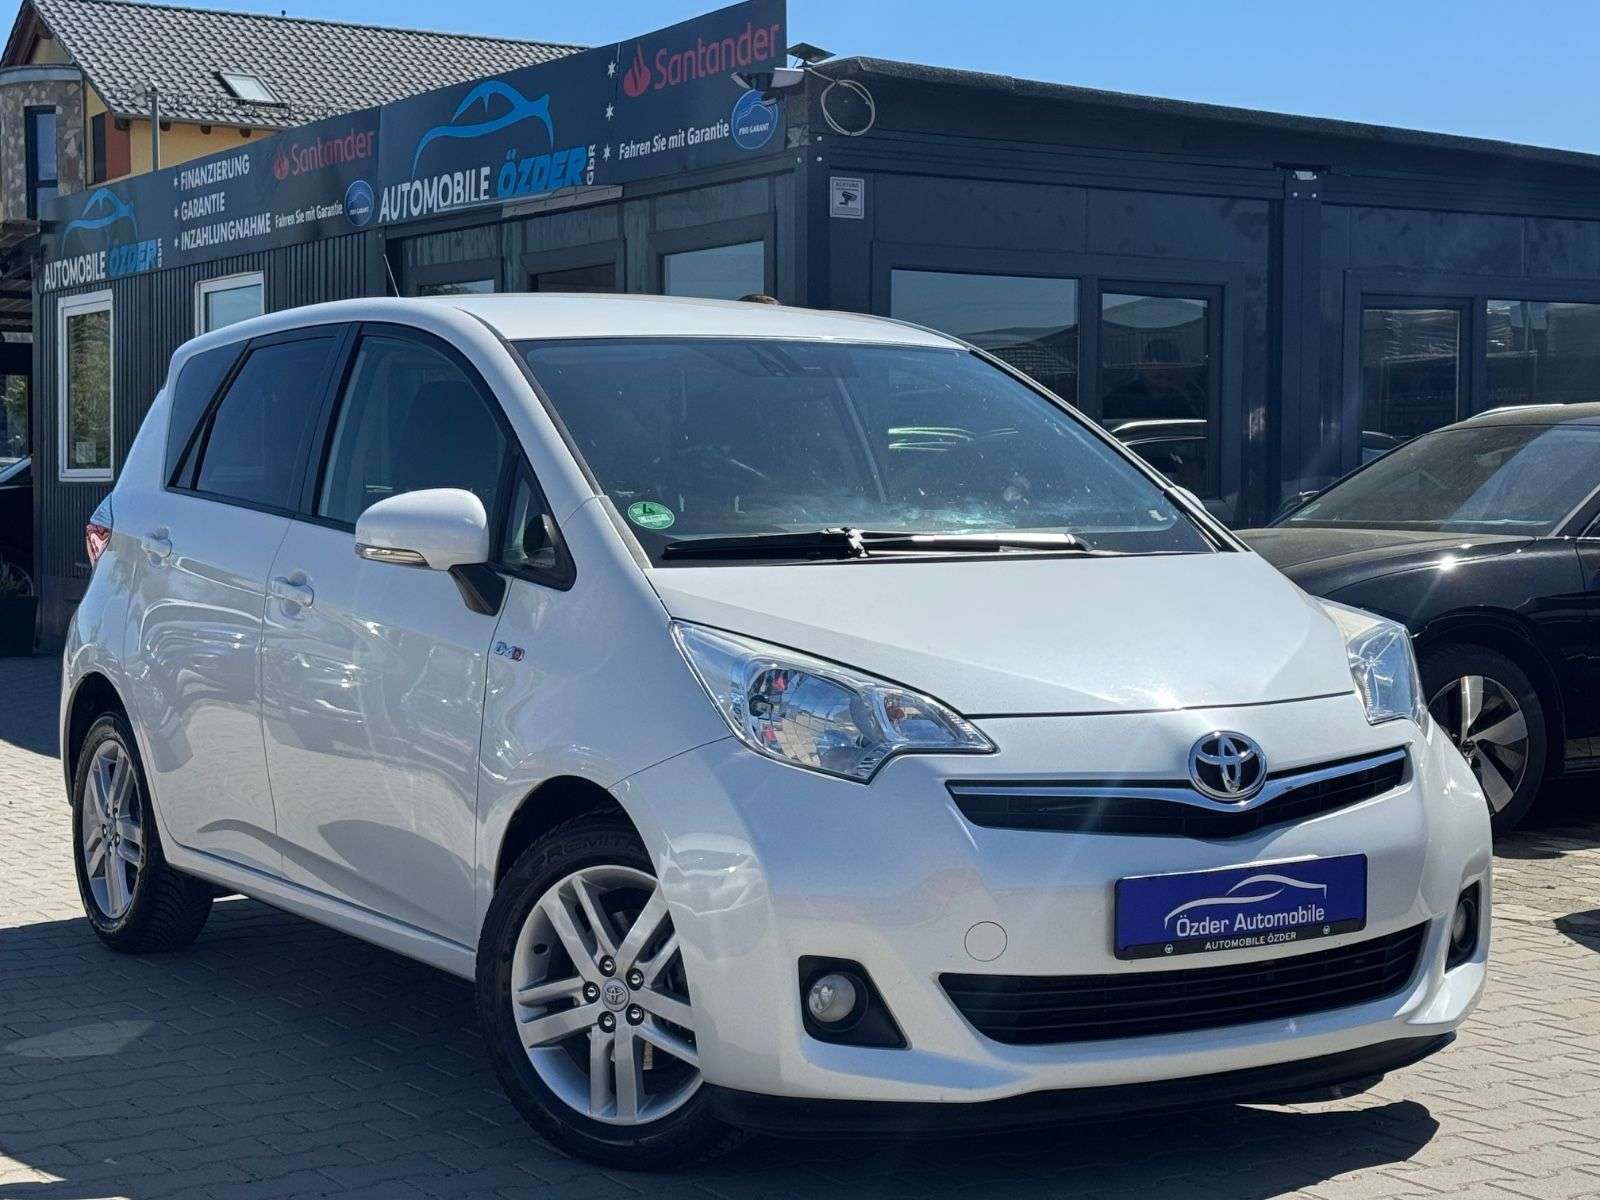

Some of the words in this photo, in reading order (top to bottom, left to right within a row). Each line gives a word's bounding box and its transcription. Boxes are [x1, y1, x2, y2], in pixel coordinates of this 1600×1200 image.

[655, 23, 781, 90] Santander
[290, 130, 375, 176] Santander
[619, 136, 651, 160] Fahren
[653, 133, 667, 152] Sie
[668, 130, 685, 148] mit
[687, 121, 730, 145] Garantie
[180, 155, 250, 191] FINANZIERUNG
[586, 144, 597, 185] GbR
[378, 166, 490, 223] AUTOMOBILE
[500, 146, 585, 198] ÖZDER
[181, 192, 226, 221] GARANTIE
[275, 213, 295, 228] Fahren
[296, 210, 304, 223] Sie
[305, 208, 316, 220] mit
[316, 203, 343, 219] Garantie
[181, 217, 271, 251] INZAHLUNGNAHME
[44, 251, 106, 290] AUTOMOBILE
[1176, 915, 1229, 937] Özder
[1233, 904, 1326, 932] Automobile
[1205, 935, 1266, 950] AUTOMOBILE
[1268, 930, 1297, 944] ÖZDER
